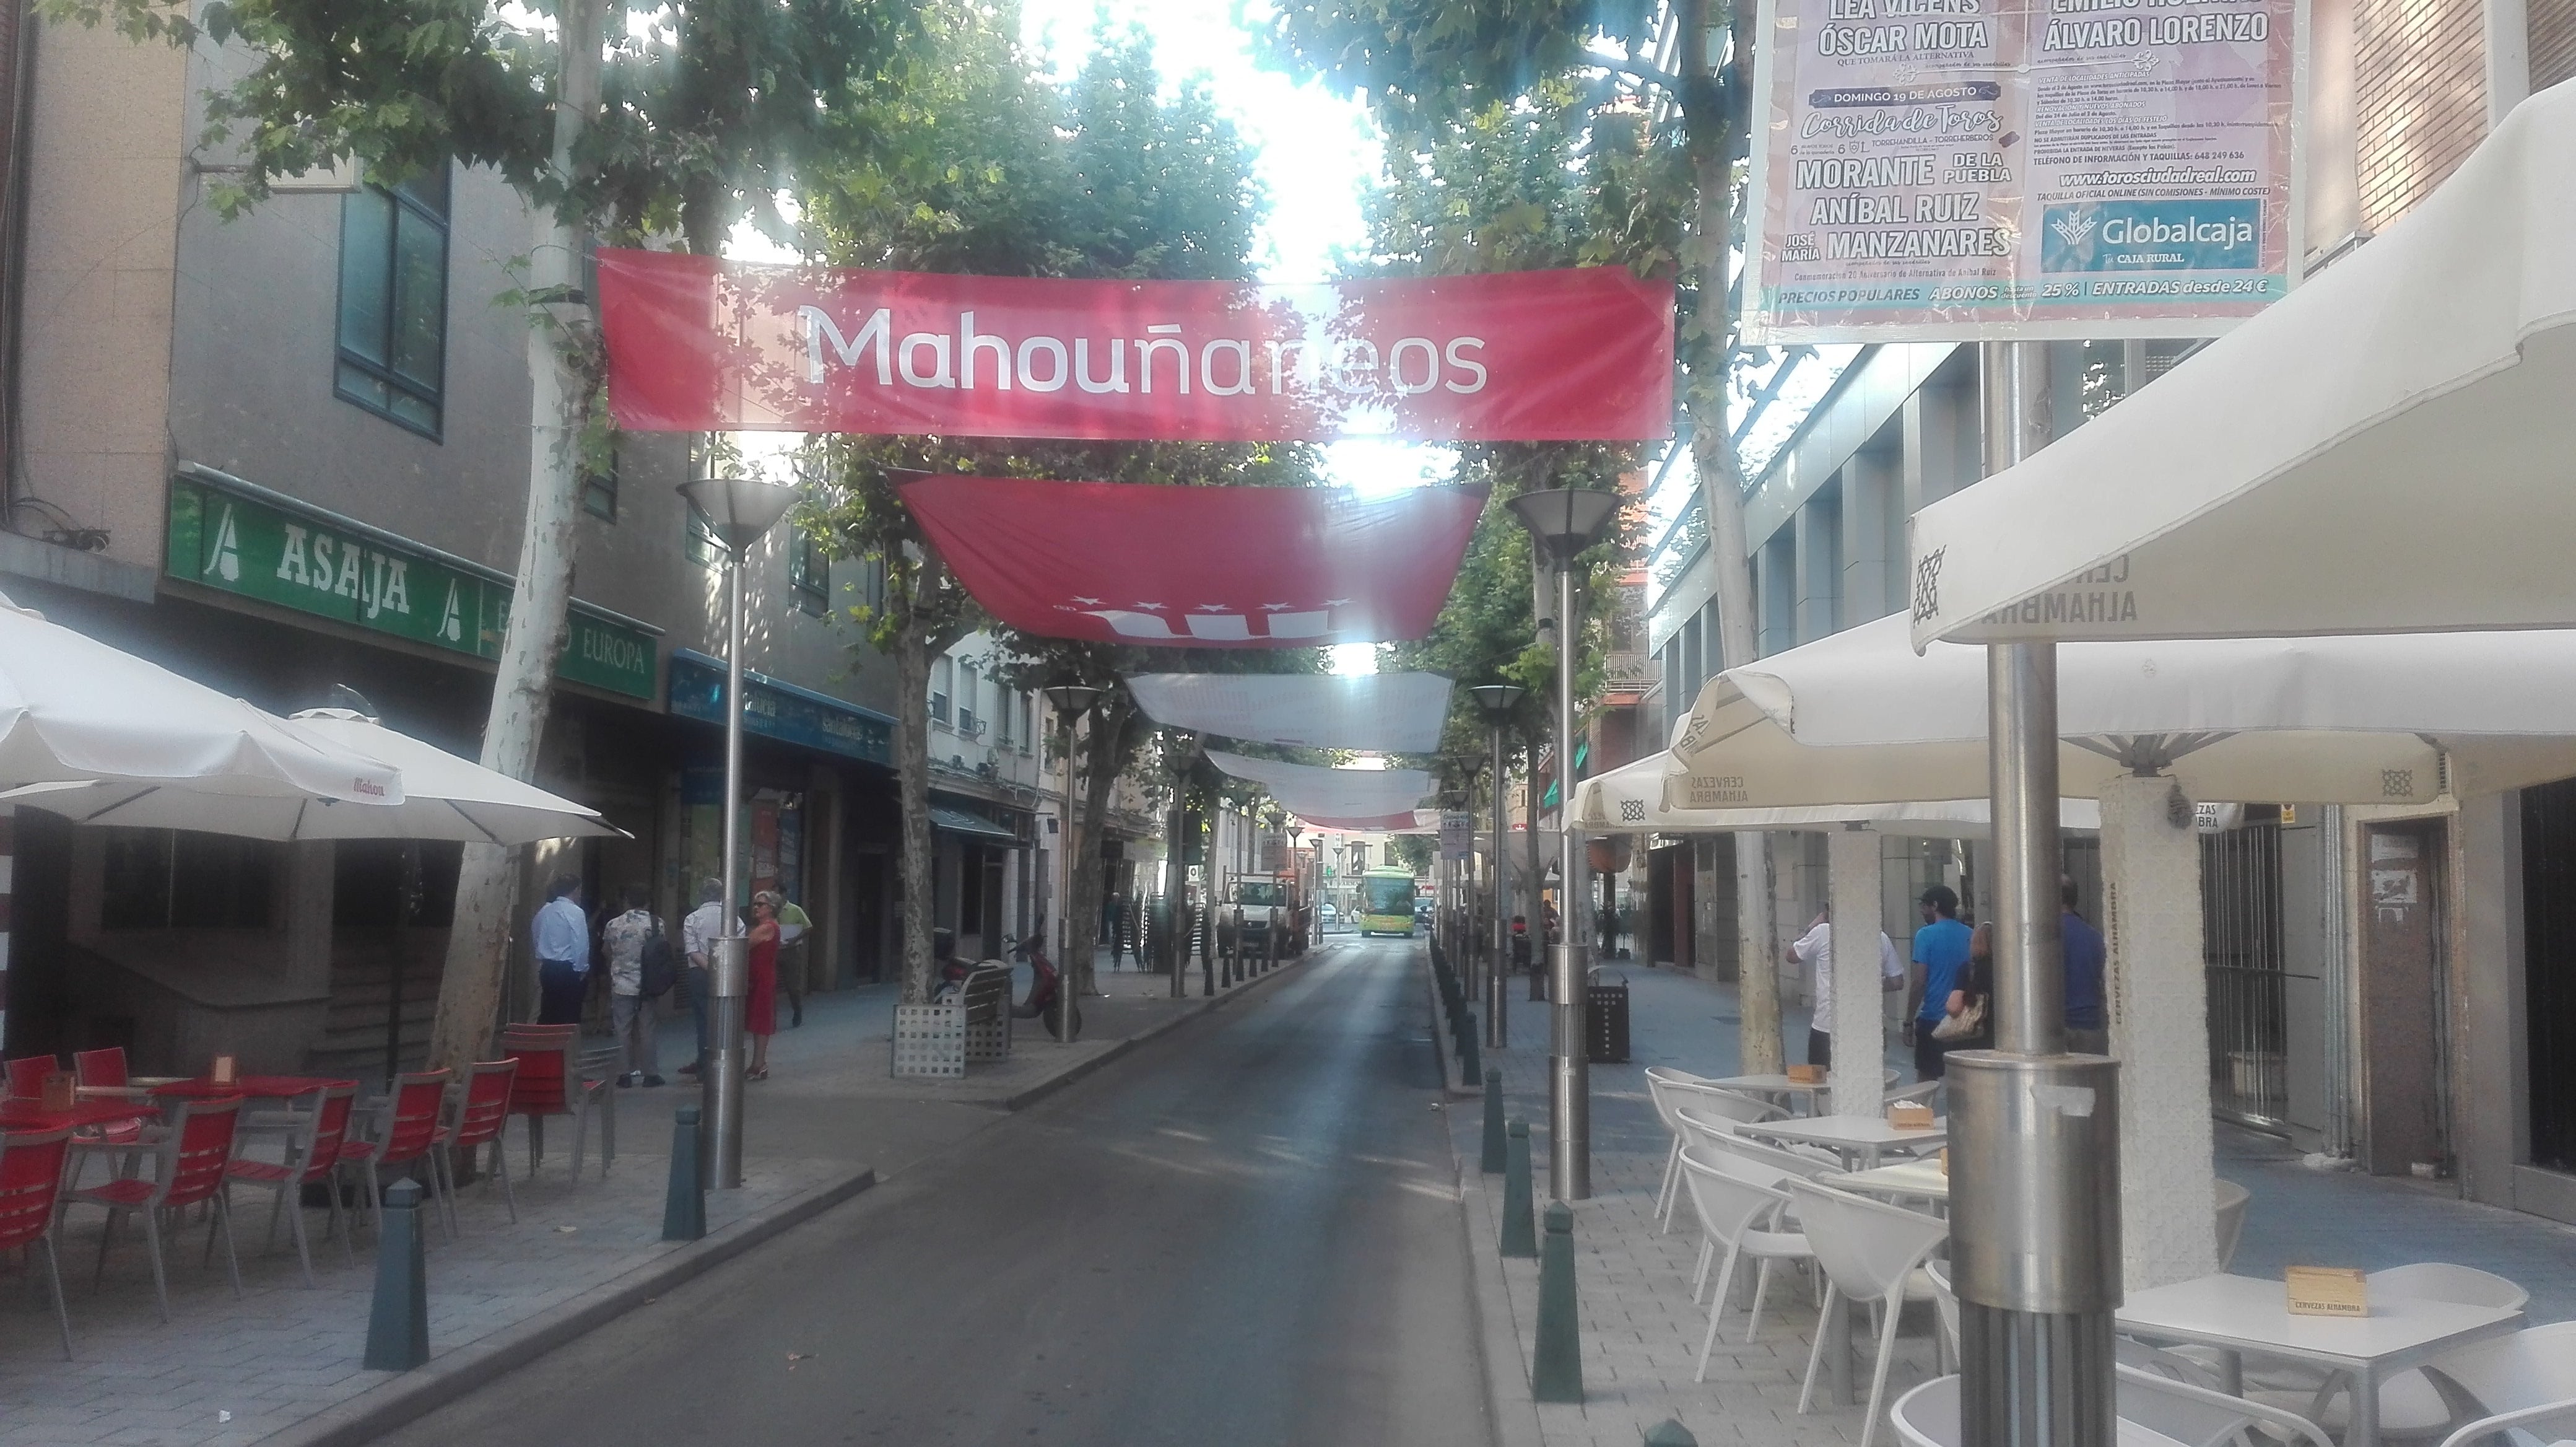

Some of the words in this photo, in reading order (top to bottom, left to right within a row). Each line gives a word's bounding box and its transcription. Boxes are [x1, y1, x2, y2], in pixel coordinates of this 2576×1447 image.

[1829, 0, 1876, 20] LEA
[1818, 23, 1907, 56] ÓSCAR
[1913, 21, 1988, 50] MOTA
[2043, 19, 2143, 52] ÁLVARO
[2149, 12, 2269, 46] LORENZO
[1837, 58, 1856, 67] QUE
[1858, 54, 1897, 65] TOMARÁ
[1913, 51, 1974, 61] ALTERNATIVA
[2039, 76, 2058, 84] VENTA
[2069, 73, 2107, 82] LOCALIDADES
[2109, 71, 2150, 79] ANTICIPADAS
[1834, 92, 1891, 102] DOMINGO
[1893, 94, 1905, 102] 19
[1909, 90, 1925, 100] DE
[1927, 87, 1977, 99] AGOSTO
[2110, 101, 2146, 109] ABONADOS
[1801, 108, 1899, 139] Corrida
[1897, 108, 1937, 132] de
[1936, 103, 2003, 134] Toros
[2035, 120, 2055, 128] VENTA
[2065, 118, 2104, 126] LOCALIDADES
[1838, 144, 1845, 154] 6
[1872, 136, 1928, 147] TORREHANDILLA
[1791, 145, 1798, 155] 6
[2034, 155, 2071, 165] TELÉFONO
[2073, 155, 2082, 164] DE
[2084, 152, 2140, 163] INFORMACIÓN
[2150, 152, 2192, 161] TAQUILLAS:
[2195, 152, 2209, 160] 648
[2212, 151, 2227, 159] 249
[1952, 152, 1978, 168] DE
[1980, 152, 2003, 167] LA
[1795, 154, 1936, 190] MORANTE
[1943, 167, 2012, 184] PUEBLA
[2059, 166, 2256, 187] www.torosciudadreal.com
[2037, 191, 2074, 201] TAQUILLA
[2076, 190, 2105, 199] OFICIAL
[2108, 188, 2136, 197] ONLINE
[2138, 188, 2154, 197] (SIN
[2155, 188, 2203, 196] COMISIONES
[2209, 186, 2241, 196] MÍNIMO
[2242, 187, 2270, 195] COSTE)
[1809, 192, 1908, 225] ANÍBAL
[1914, 192, 1980, 223] RUIZ
[1785, 231, 1816, 248] JOSÉ
[2102, 216, 2252, 250] Globalcaja
[1825, 227, 2012, 260] MANZANARES
[1780, 247, 1821, 263] MARÍA
[2117, 254, 2144, 263] CAJA
[2146, 253, 2184, 263] RURAL
[1848, 271, 1857, 279] 20
[1859, 270, 1896, 279] Aniversario
[1899, 269, 1907, 278] de
[1909, 269, 1946, 278] Alternativa
[1982, 268, 1996, 276] Ruiz
[1778, 290, 1835, 304] PRECIOS
[1838, 288, 1920, 302] POPULARES
[1928, 285, 1998, 300] ABONOS
[2042, 282, 2062, 297] 25
[2092, 281, 2181, 295] ENTRADAS
[2183, 280, 2230, 294] desde
[2232, 279, 2254, 294] 24
[276, 523, 410, 619] ASAJA
[583, 628, 645, 674] EUROPA
[354, 777, 385, 797] Mahou
[2110, 882, 2119, 955] ALHAMBRA
[2113, 960, 2122, 1025] CERVEZAS
[2295, 1301, 2325, 1310] CERVEZAS
